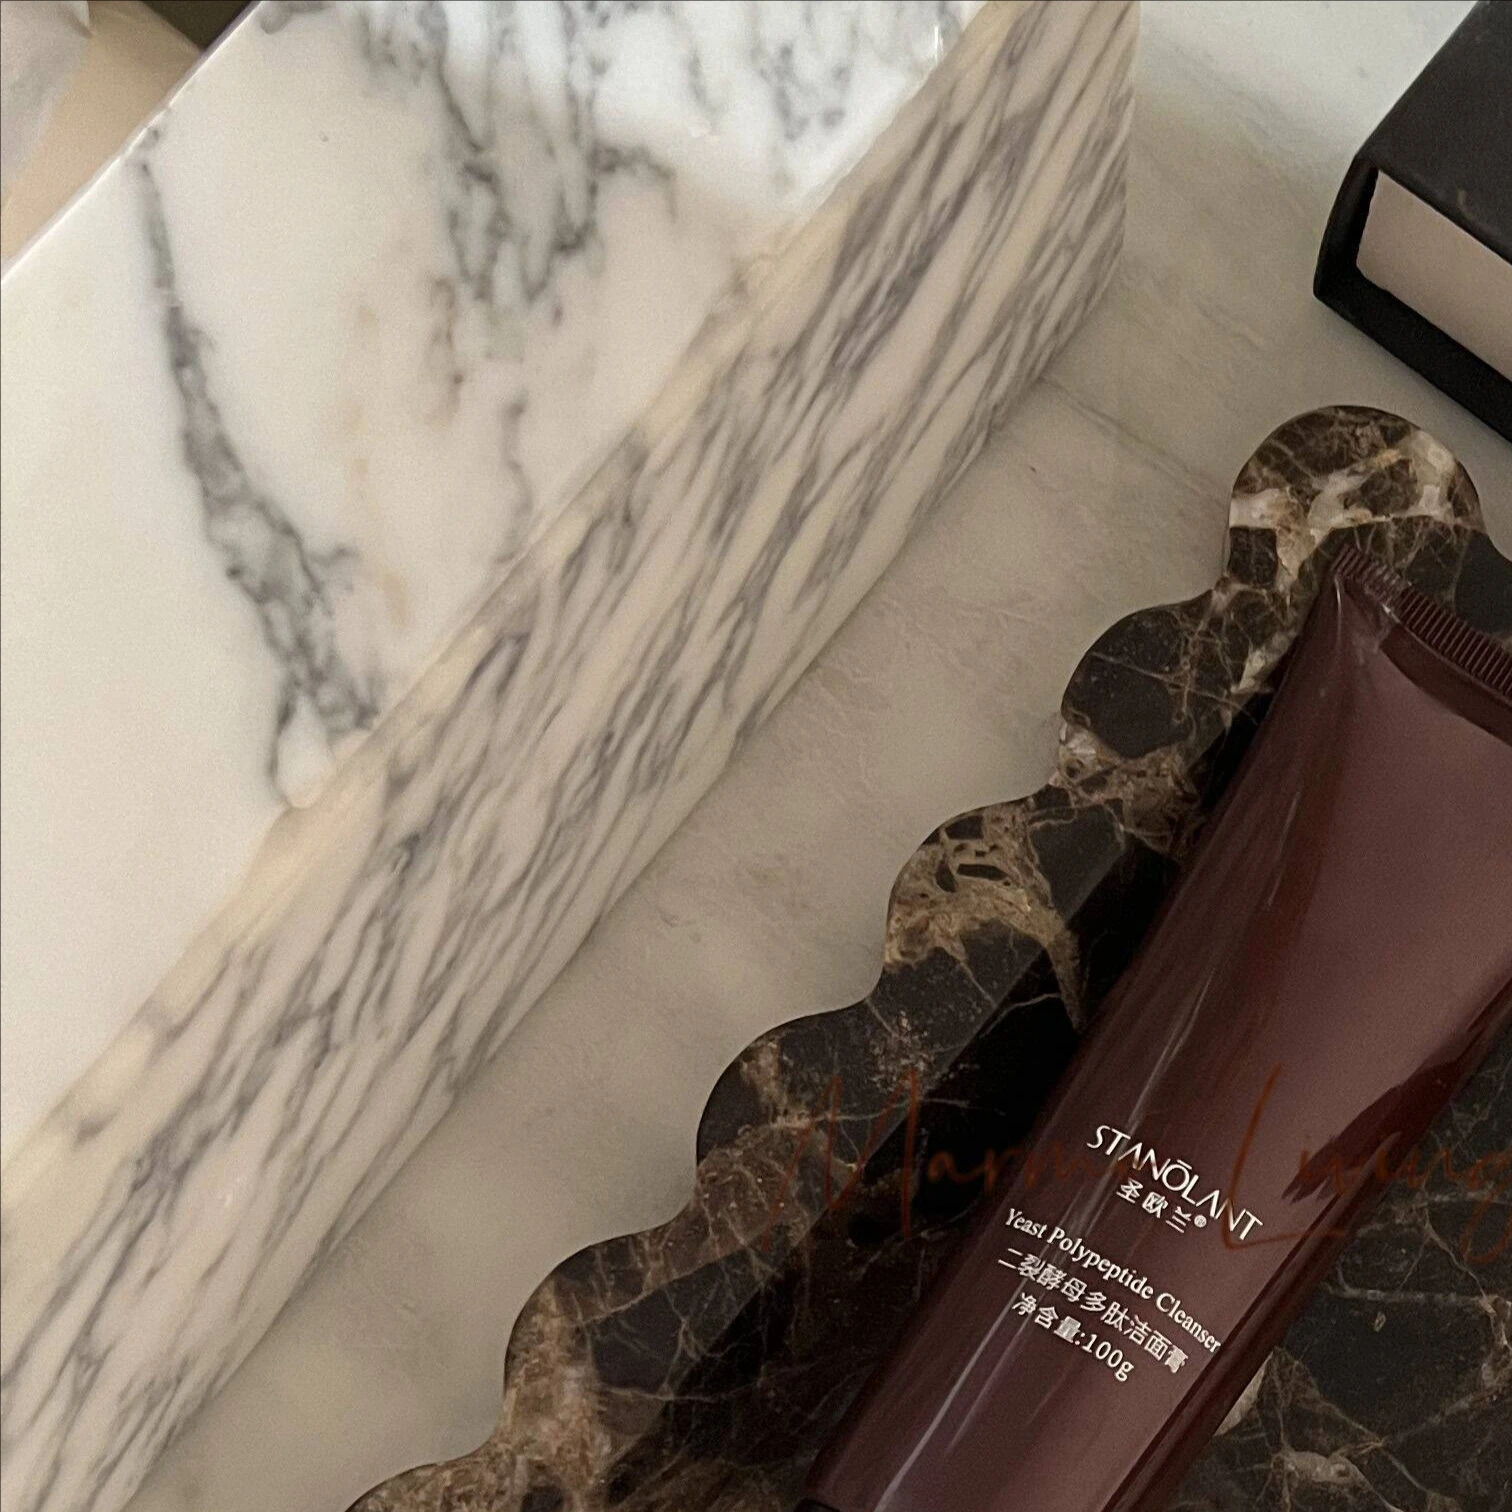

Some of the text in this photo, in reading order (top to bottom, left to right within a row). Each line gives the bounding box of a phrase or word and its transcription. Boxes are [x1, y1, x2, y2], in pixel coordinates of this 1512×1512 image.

[998, 1247, 1189, 1374] 二裂酵母多肽洁面膏
[1005, 1208, 1222, 1353] Yeast Polypeptide Cleanser
